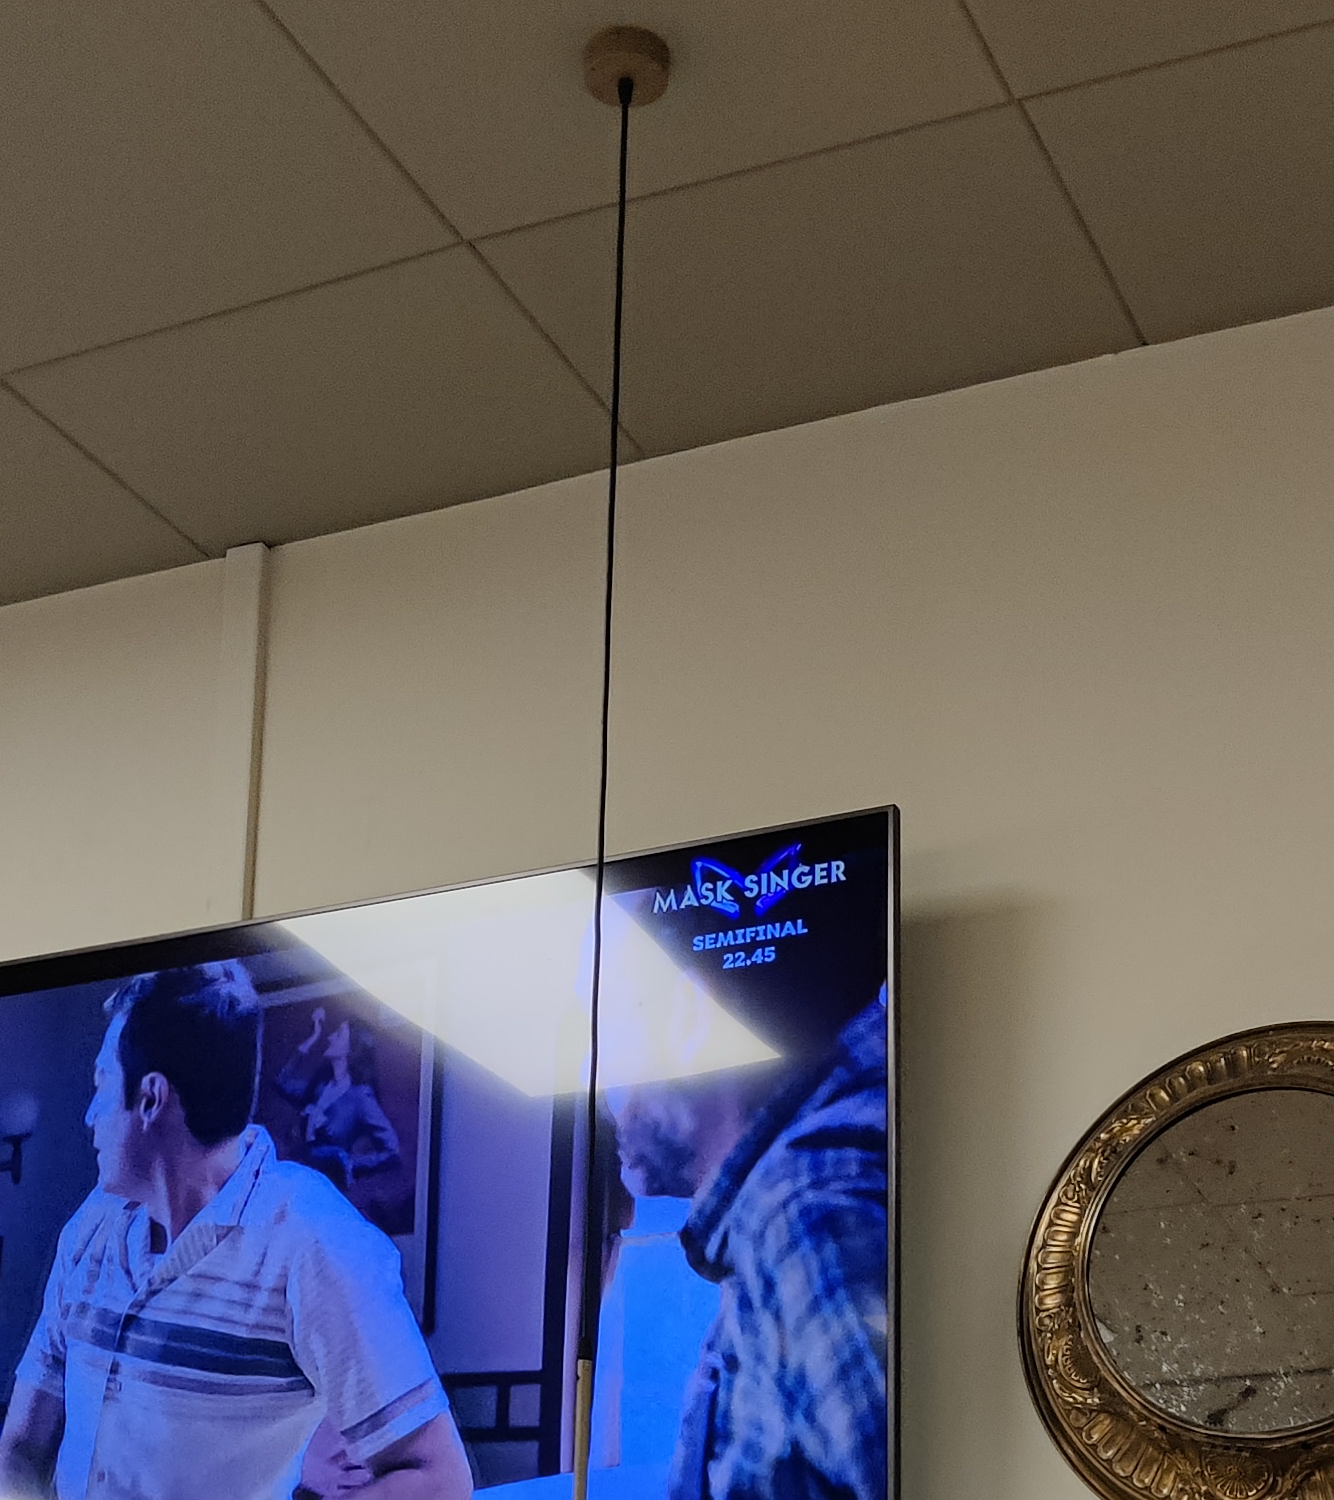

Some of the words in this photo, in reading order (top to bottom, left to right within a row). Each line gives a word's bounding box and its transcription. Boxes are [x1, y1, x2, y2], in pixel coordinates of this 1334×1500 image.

[653, 880, 734, 914] MASK
[744, 861, 846, 898] SINGER
[692, 919, 808, 951] SEMIFINAL
